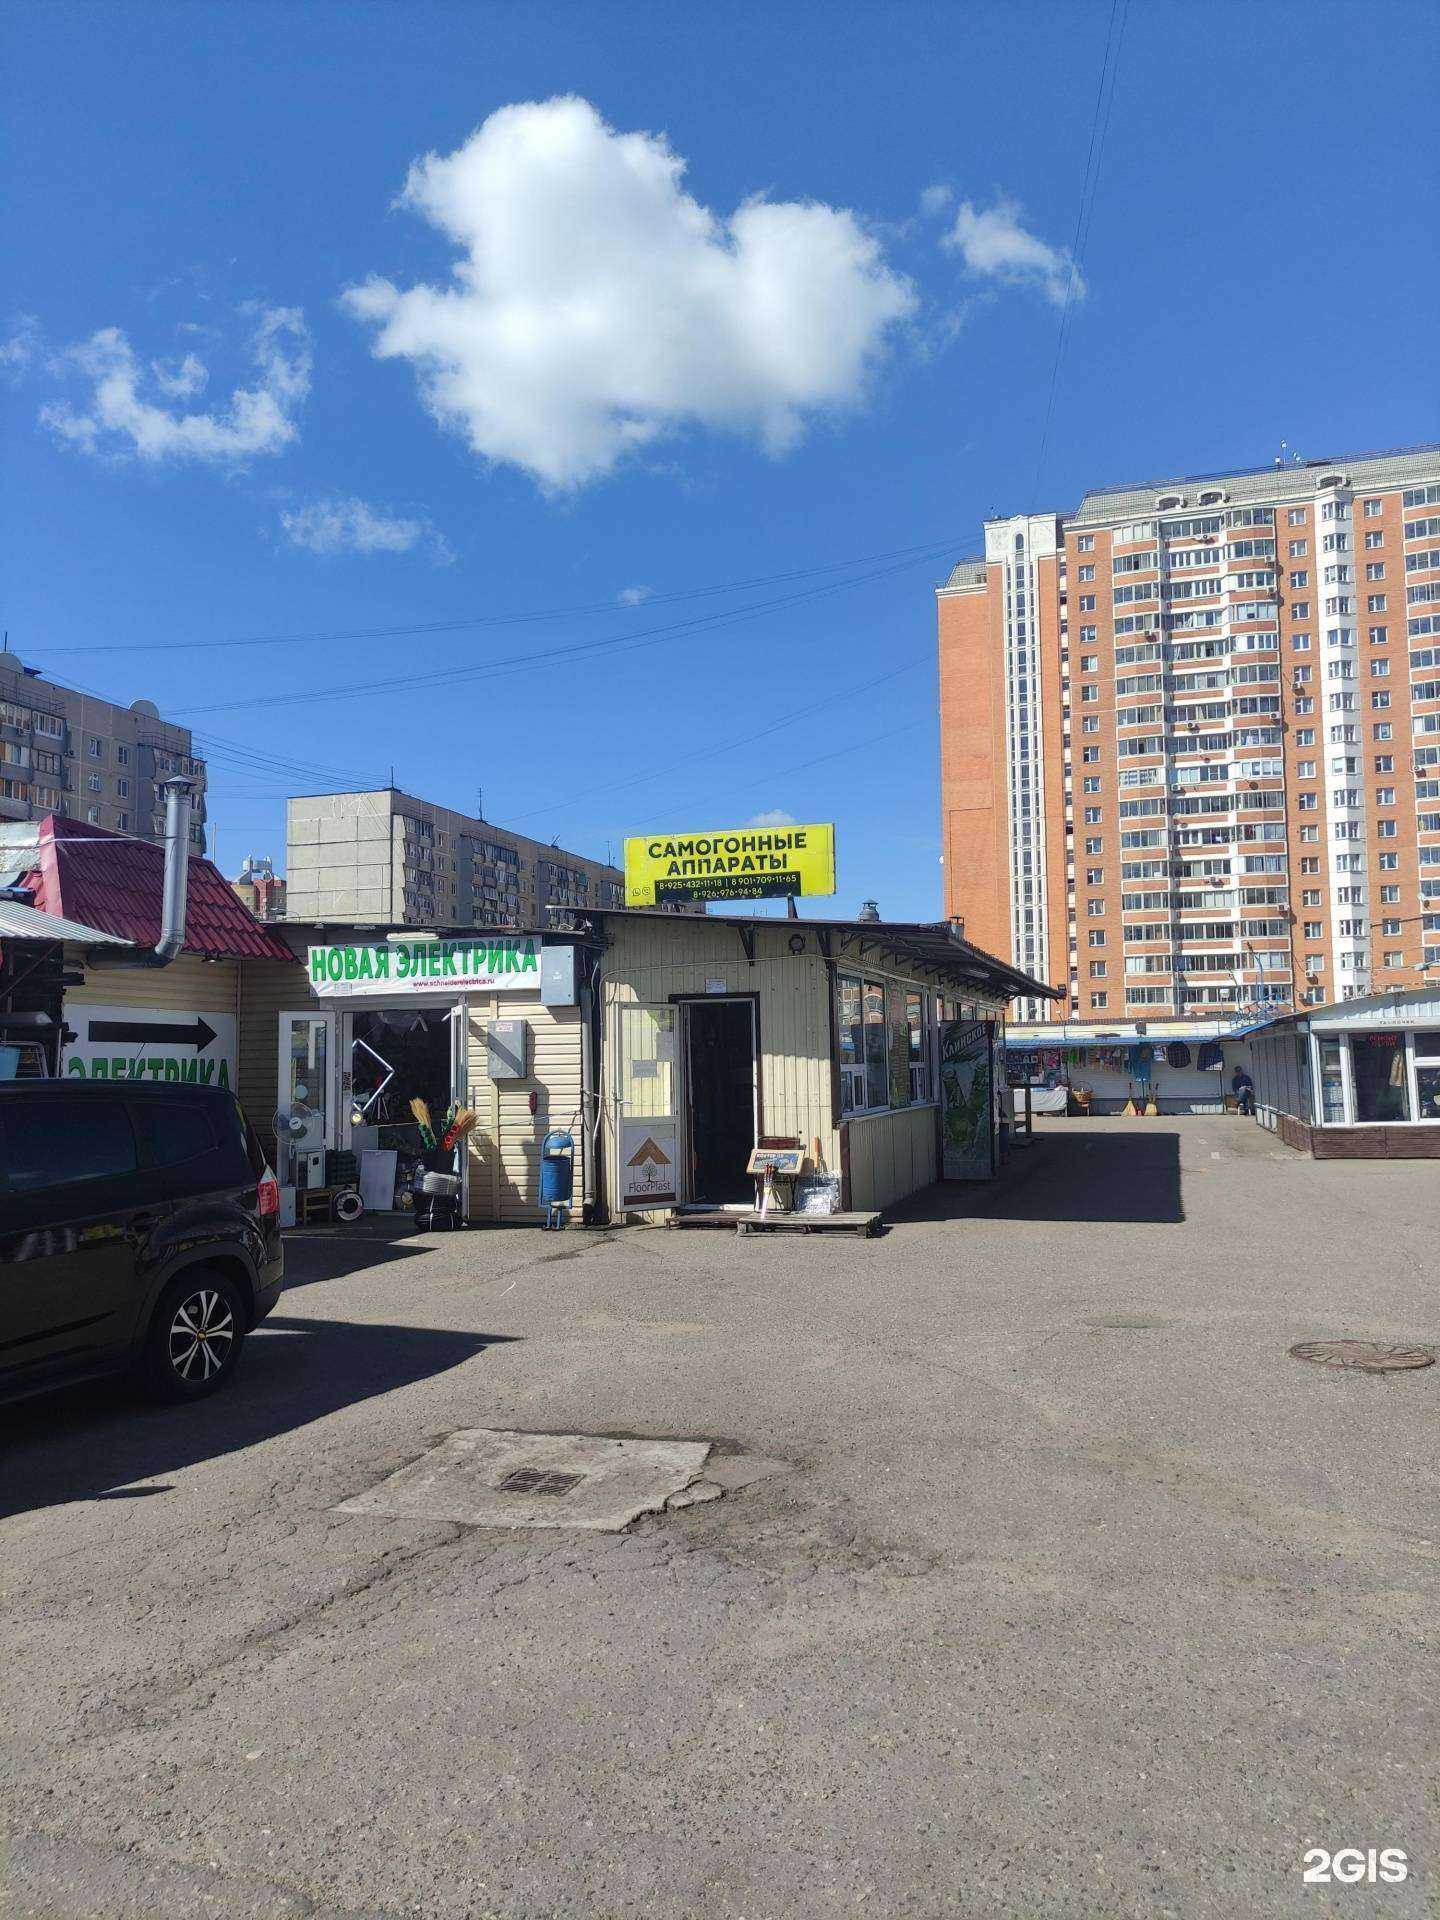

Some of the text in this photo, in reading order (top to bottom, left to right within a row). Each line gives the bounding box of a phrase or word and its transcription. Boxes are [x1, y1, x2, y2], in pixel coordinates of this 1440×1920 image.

[649, 832, 807, 858] САМОГОННЫЕ
[667, 853, 787, 876] АППАРАТЫ
[312, 938, 538, 981] НОВАЯ ЭЛЕКТРИКА
[628, 1181, 670, 1192] FloorPlast
